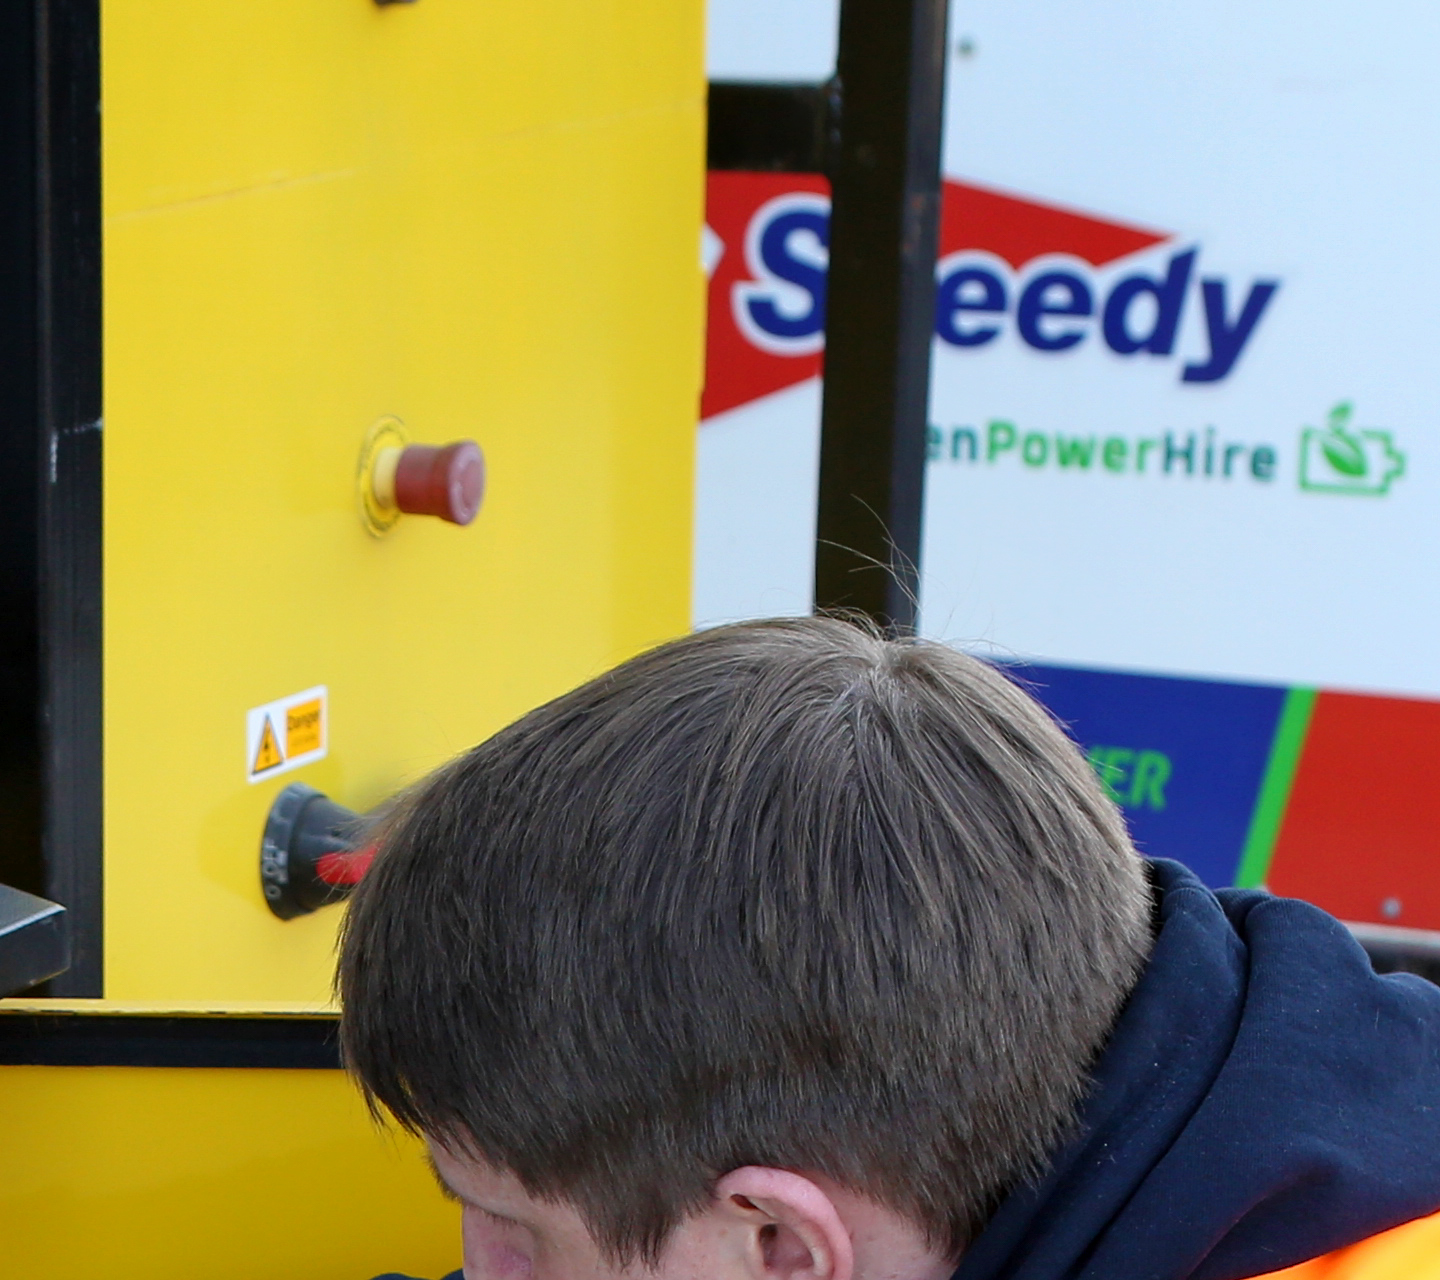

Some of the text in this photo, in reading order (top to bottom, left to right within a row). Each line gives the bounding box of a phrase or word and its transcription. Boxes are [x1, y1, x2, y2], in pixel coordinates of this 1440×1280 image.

[744, 204, 1282, 384] Seedy
[925, 418, 1277, 482] enPowerHire
[1090, 746, 1173, 812] ER
